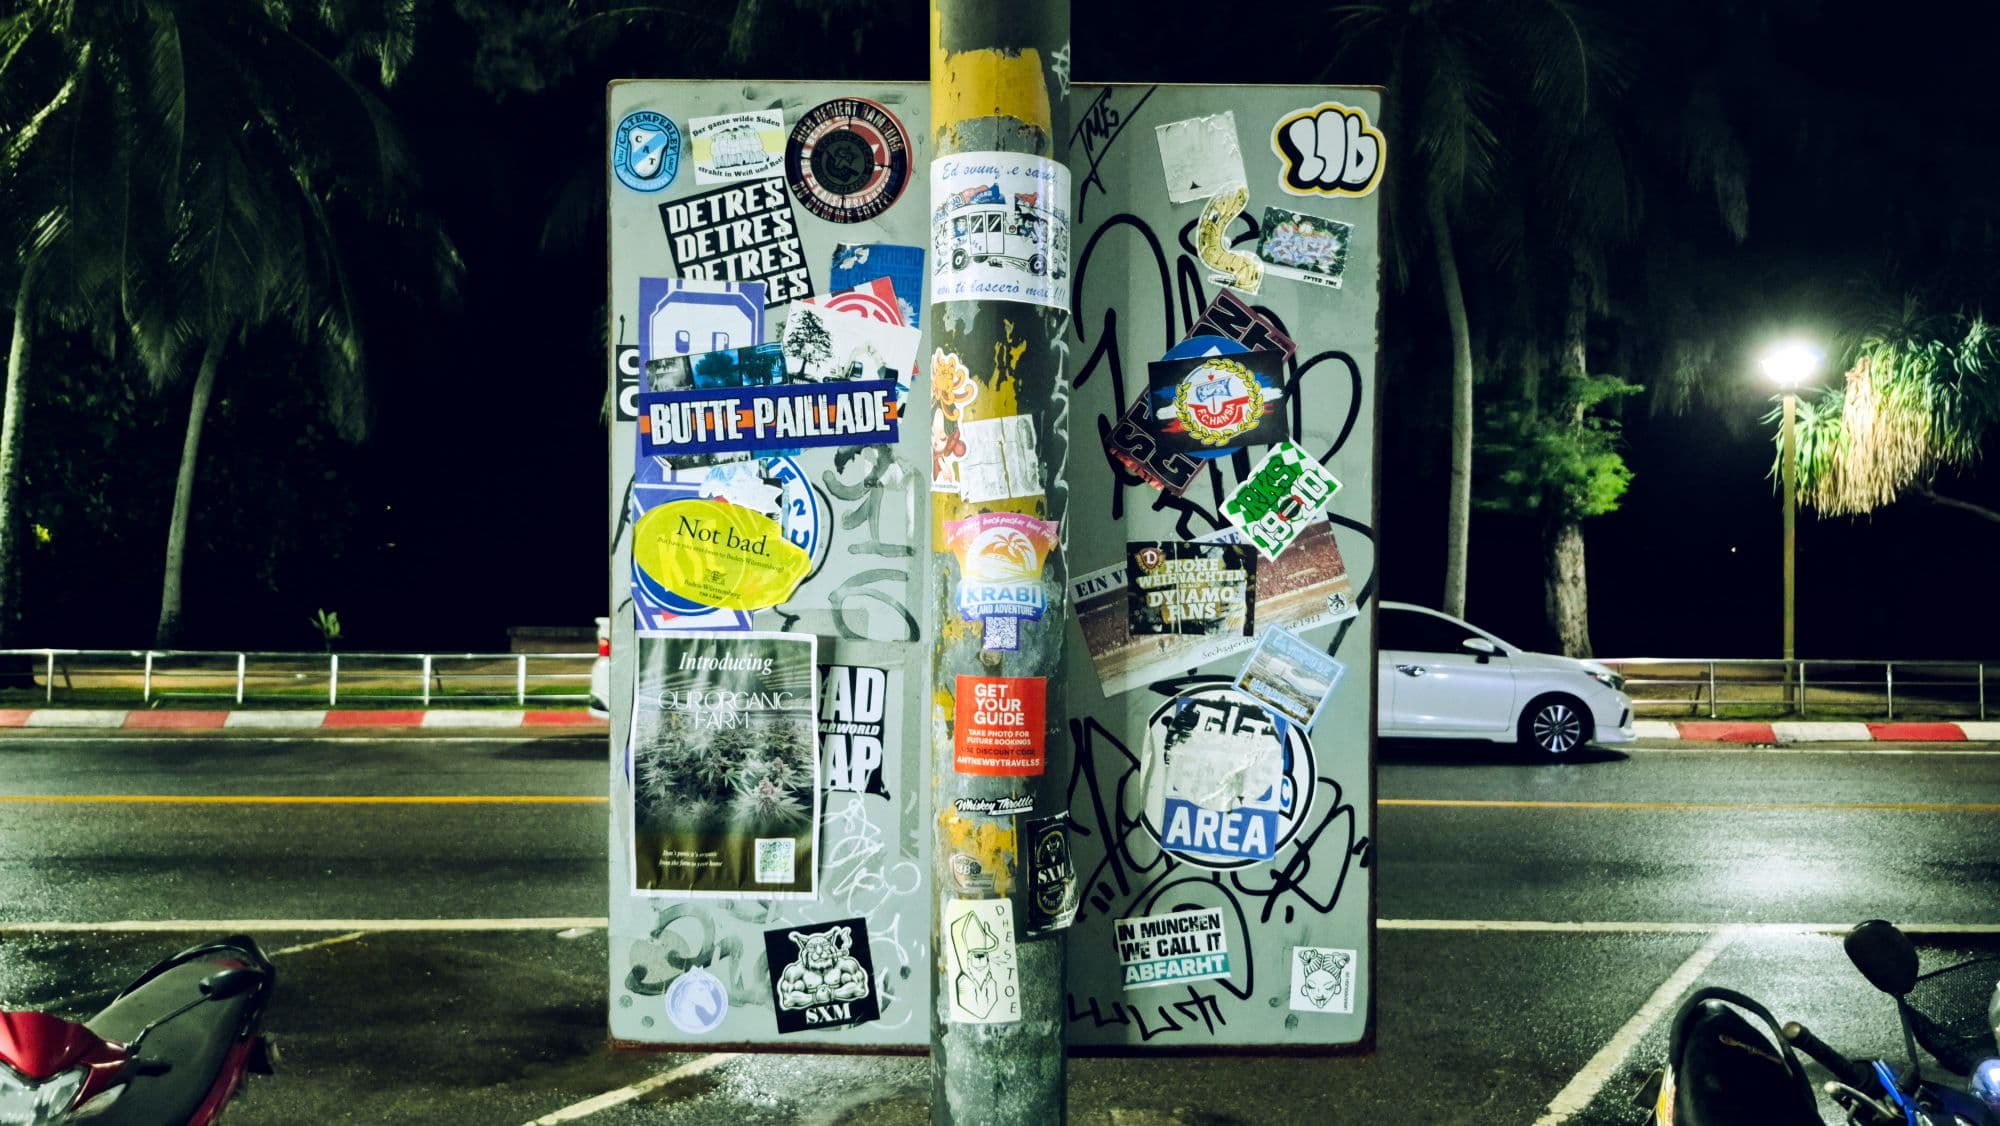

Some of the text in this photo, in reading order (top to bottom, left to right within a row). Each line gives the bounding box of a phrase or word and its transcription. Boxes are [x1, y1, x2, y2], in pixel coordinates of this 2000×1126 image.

[732, 115, 754, 124] wilde
[756, 116, 781, 127] Süden
[755, 164, 769, 174] und
[666, 177, 786, 235] DETRES
[674, 207, 793, 264] DETRES
[649, 389, 892, 447] BUTTE PAILLADE
[677, 515, 770, 557] Not bad.
[1165, 558, 1220, 574] FROHE
[966, 586, 1037, 604] KRABI
[1074, 575, 1109, 599] EIN
[678, 651, 774, 676] Introducing
[657, 690, 793, 710] OUR ORGANIC
[974, 683, 1009, 698] GET
[974, 698, 1021, 712] YOUR
[695, 711, 749, 730] FARM
[973, 711, 1025, 726] GUIDE
[818, 722, 881, 737] ARWORLD
[968, 728, 1030, 738] TAKE PHOTO FOR
[966, 736, 1032, 746] FUTURE BOOKINGS
[976, 748, 1015, 756] DISCOUNT
[955, 795, 1034, 815] Whiskey Throttle
[1165, 806, 1267, 855] AREA
[1117, 923, 1136, 942] IN
[1120, 932, 1222, 962] WE CALL IT
[1125, 953, 1225, 984] ABFARHT
[805, 1002, 852, 1025] SXM
